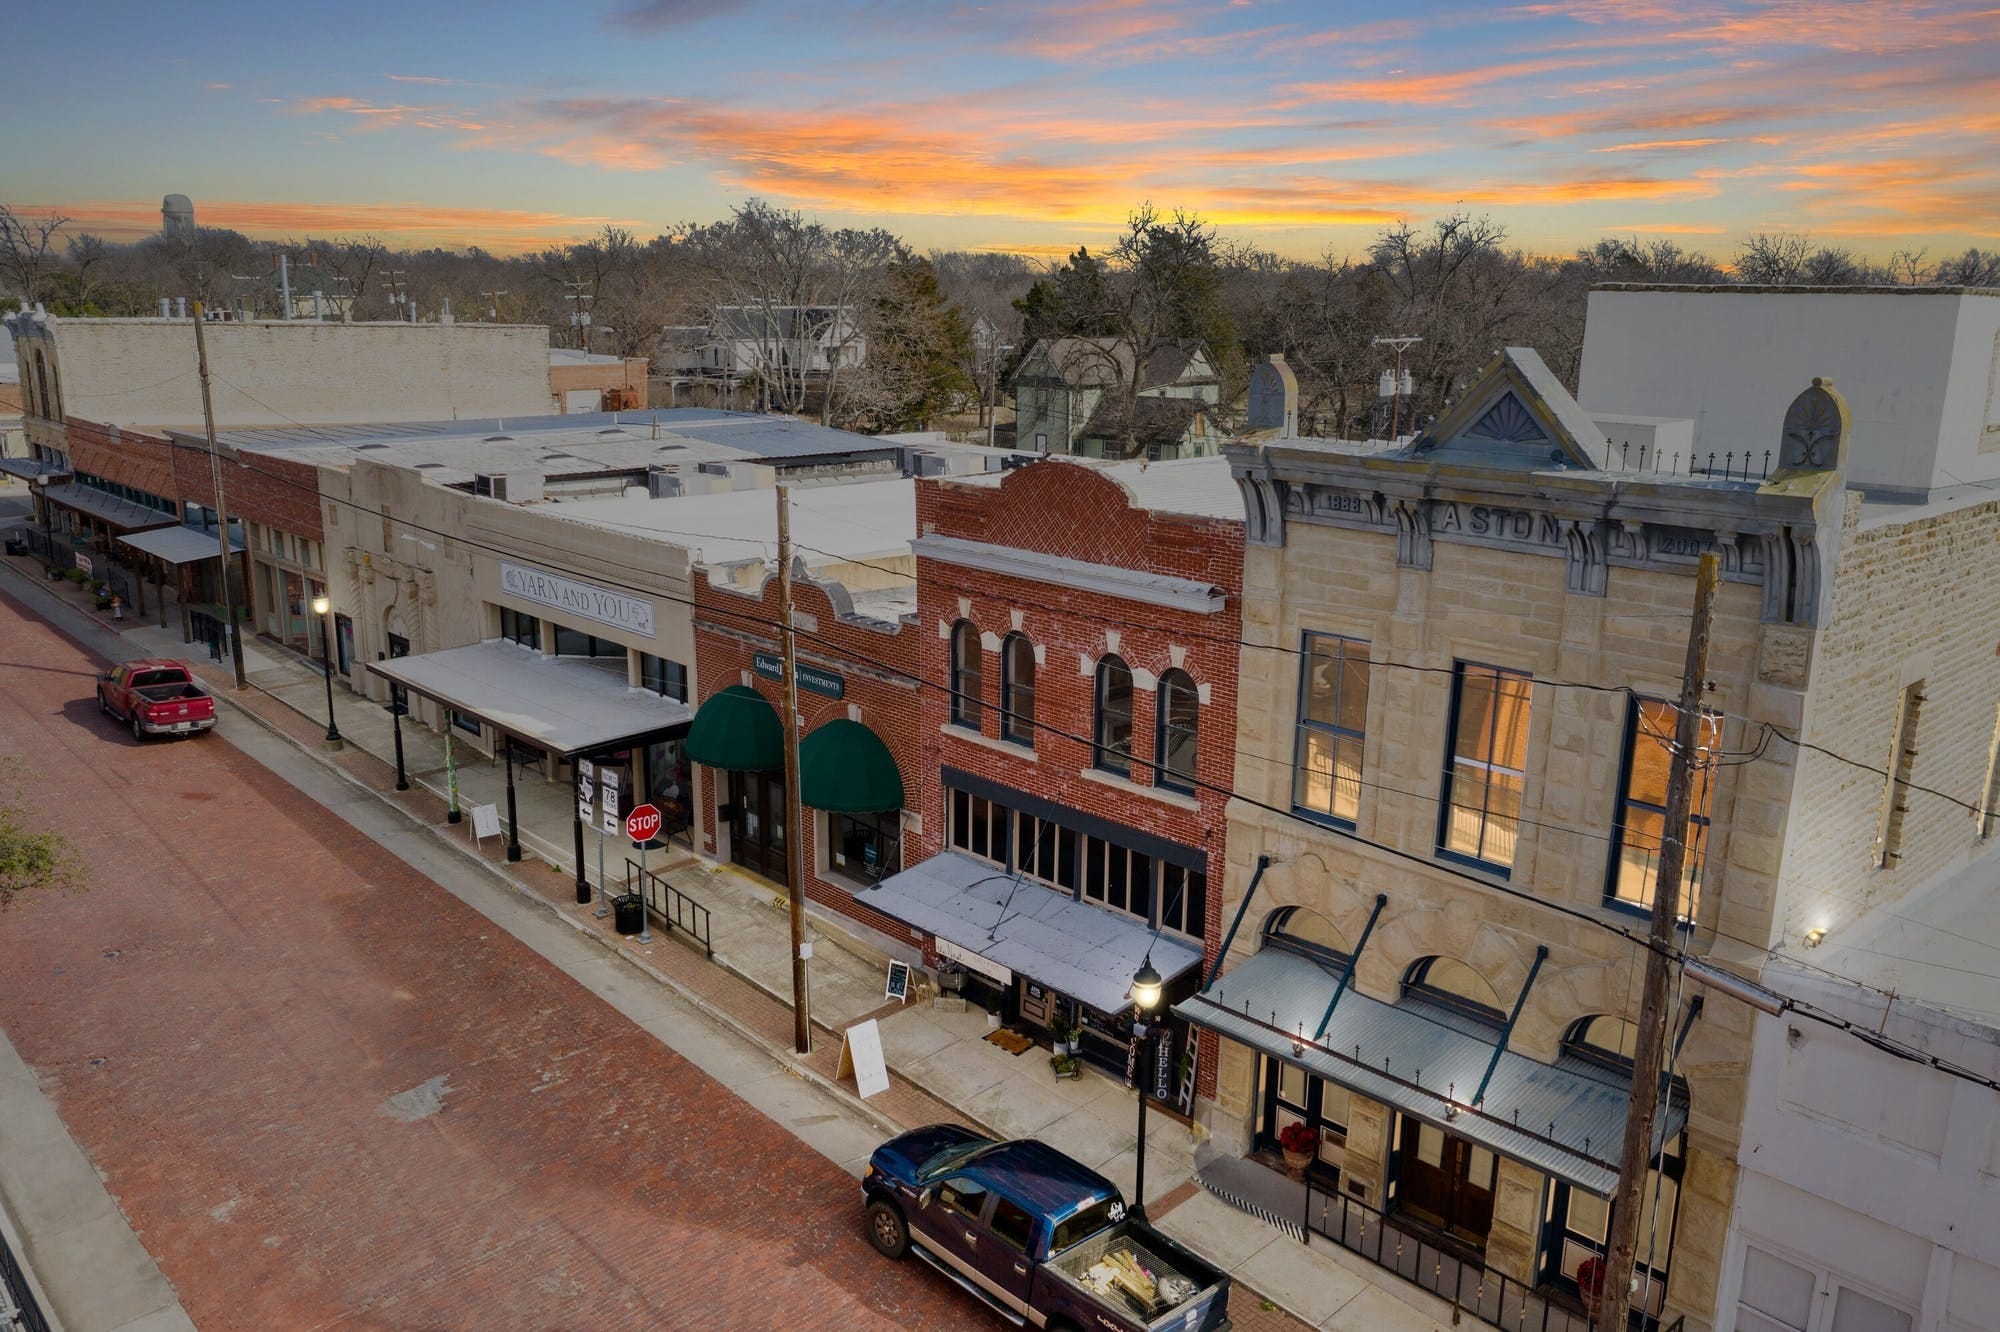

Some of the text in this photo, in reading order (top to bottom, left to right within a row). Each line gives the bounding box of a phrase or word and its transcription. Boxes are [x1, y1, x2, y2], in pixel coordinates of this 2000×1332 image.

[1327, 495, 1361, 513] 1888
[1442, 504, 1561, 544] ASTON
[518, 571, 630, 622] YARN AND YOU
[756, 656, 779, 673] Edward
[803, 673, 840, 691] INVESTMENTS
[605, 789, 615, 803] 78
[629, 814, 658, 833] STOP
[1157, 1046, 1170, 1099] HELLO
